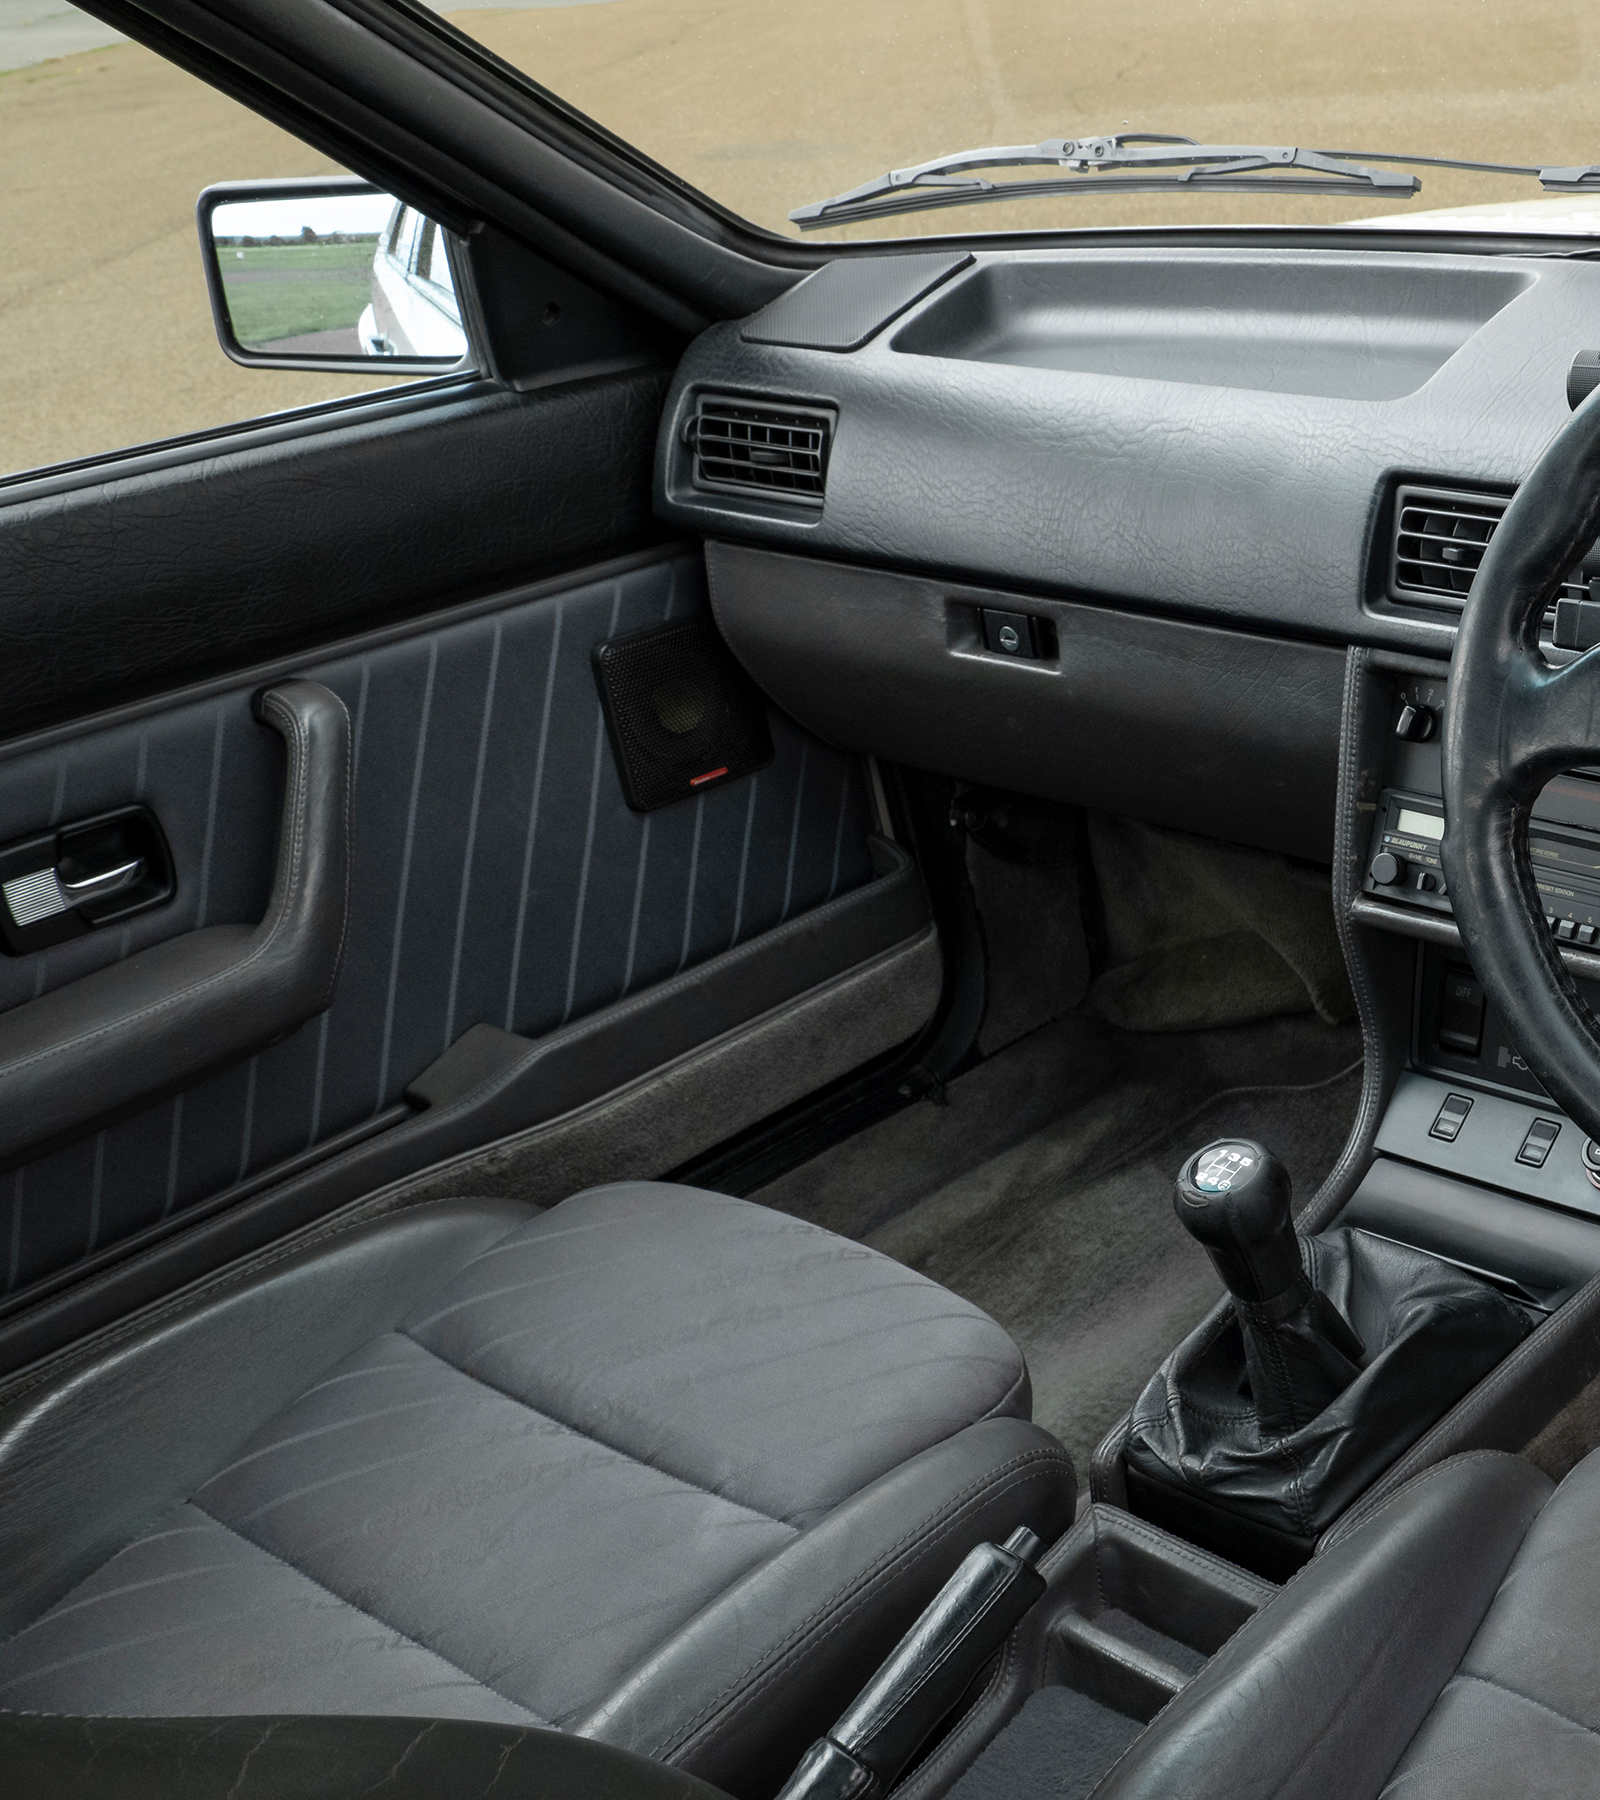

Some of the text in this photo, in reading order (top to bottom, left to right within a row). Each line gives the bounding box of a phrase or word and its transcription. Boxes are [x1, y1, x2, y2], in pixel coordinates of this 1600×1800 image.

[1428, 688, 1434, 696] 2
[1440, 699, 1445, 707] 3
[1391, 837, 1427, 850] BLAUPUNKT
[1555, 887, 1574, 896] STATION
[1455, 986, 1472, 999] DIFF
[1219, 1149, 1254, 1167] 1 3 5
[1195, 1172, 1208, 1182] 2
[1207, 1177, 1220, 1186] 4
